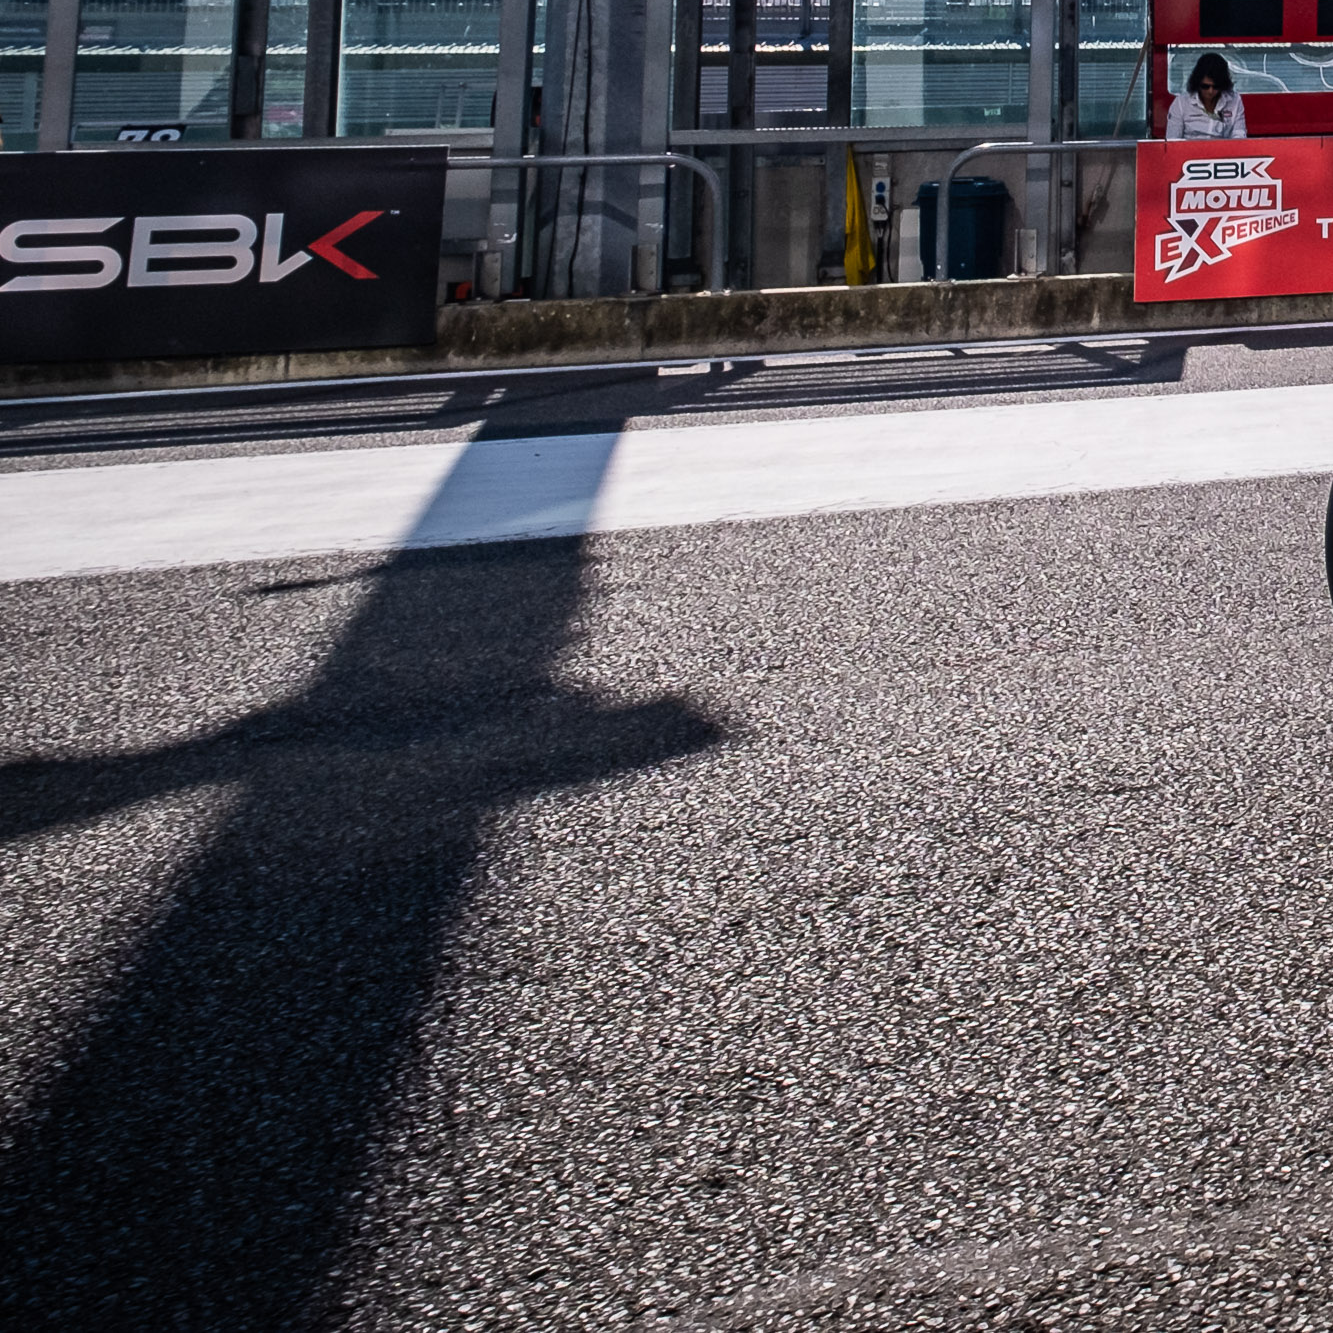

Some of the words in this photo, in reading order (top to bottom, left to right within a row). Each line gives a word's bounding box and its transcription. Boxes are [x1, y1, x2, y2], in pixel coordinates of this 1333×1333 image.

[1186, 161, 1266, 181] SBK
[1180, 187, 1273, 210] MOTUL
[0, 209, 386, 293] SBK
